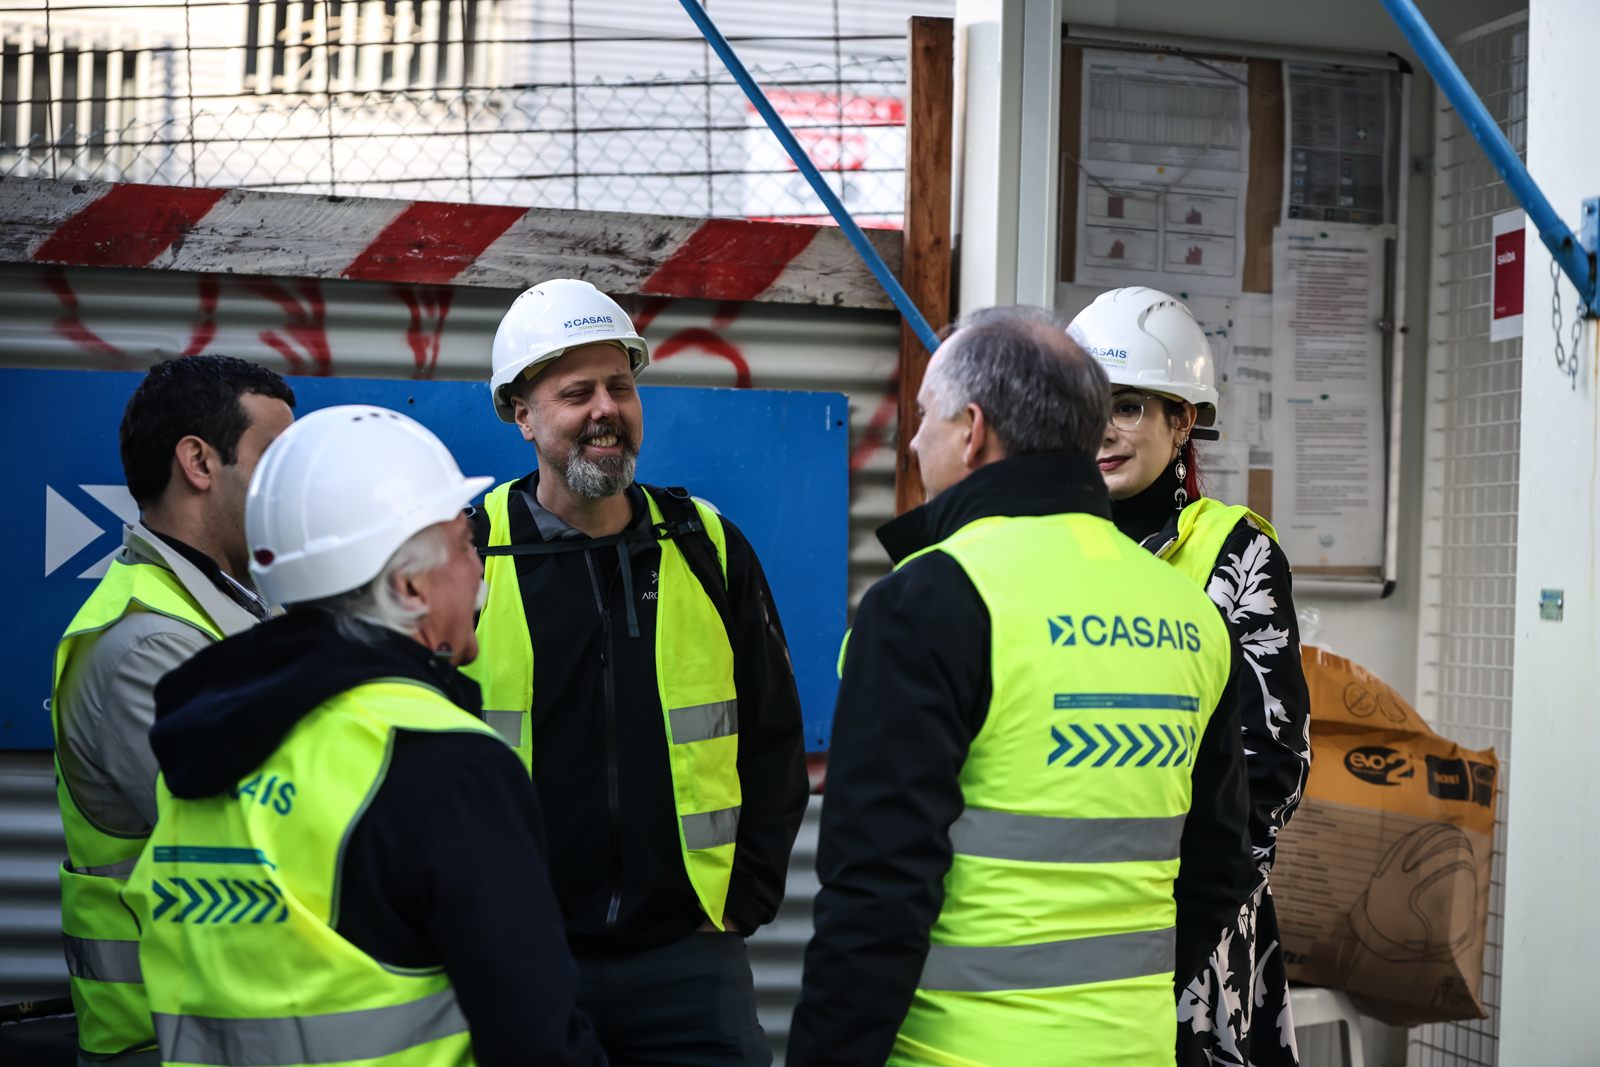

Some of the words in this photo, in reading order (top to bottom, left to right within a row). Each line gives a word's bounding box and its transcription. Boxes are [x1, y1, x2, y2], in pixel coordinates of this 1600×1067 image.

[573, 316, 613, 326] CASAIS
[1081, 614, 1201, 653] CASAIS
[239, 774, 297, 816] AIS
